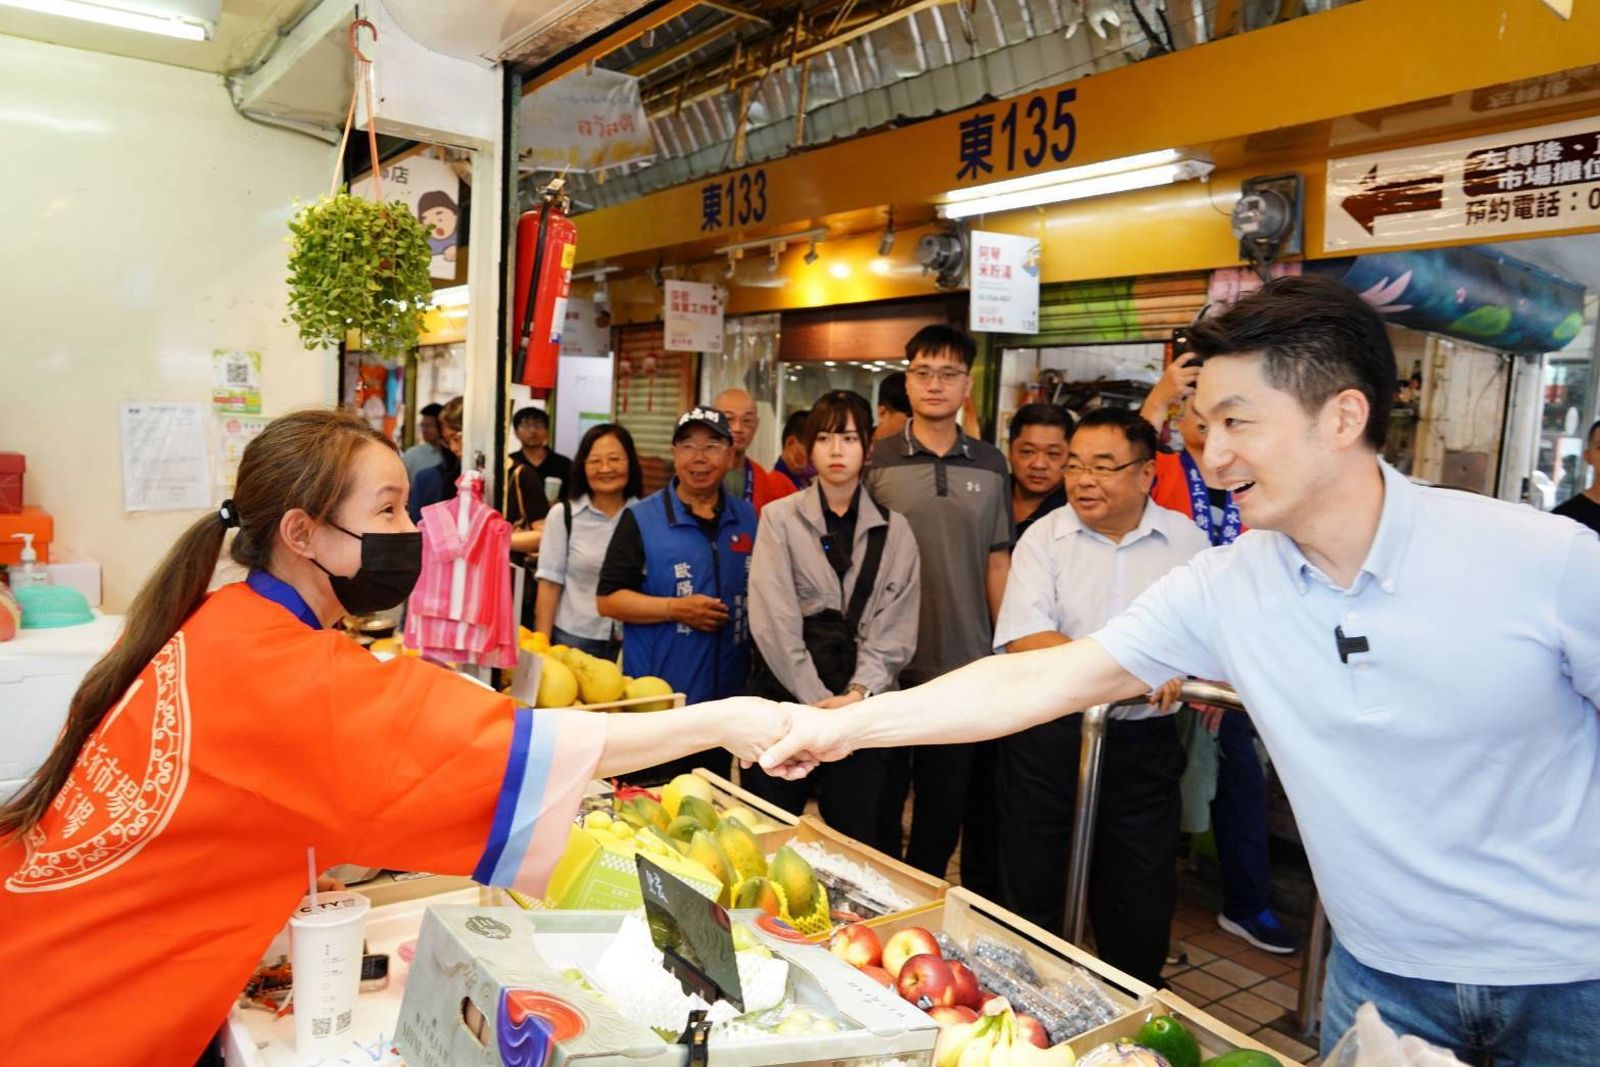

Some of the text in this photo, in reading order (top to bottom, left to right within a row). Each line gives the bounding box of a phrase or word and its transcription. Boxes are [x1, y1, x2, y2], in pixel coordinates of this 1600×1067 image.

[577, 112, 636, 139] สวัสดี
[956, 88, 1077, 182] 東135
[1479, 135, 1600, 171] 左轉後、
[1498, 158, 1600, 190] 市場攤位
[701, 168, 767, 232] 東133
[300, 900, 340, 914] CTY
